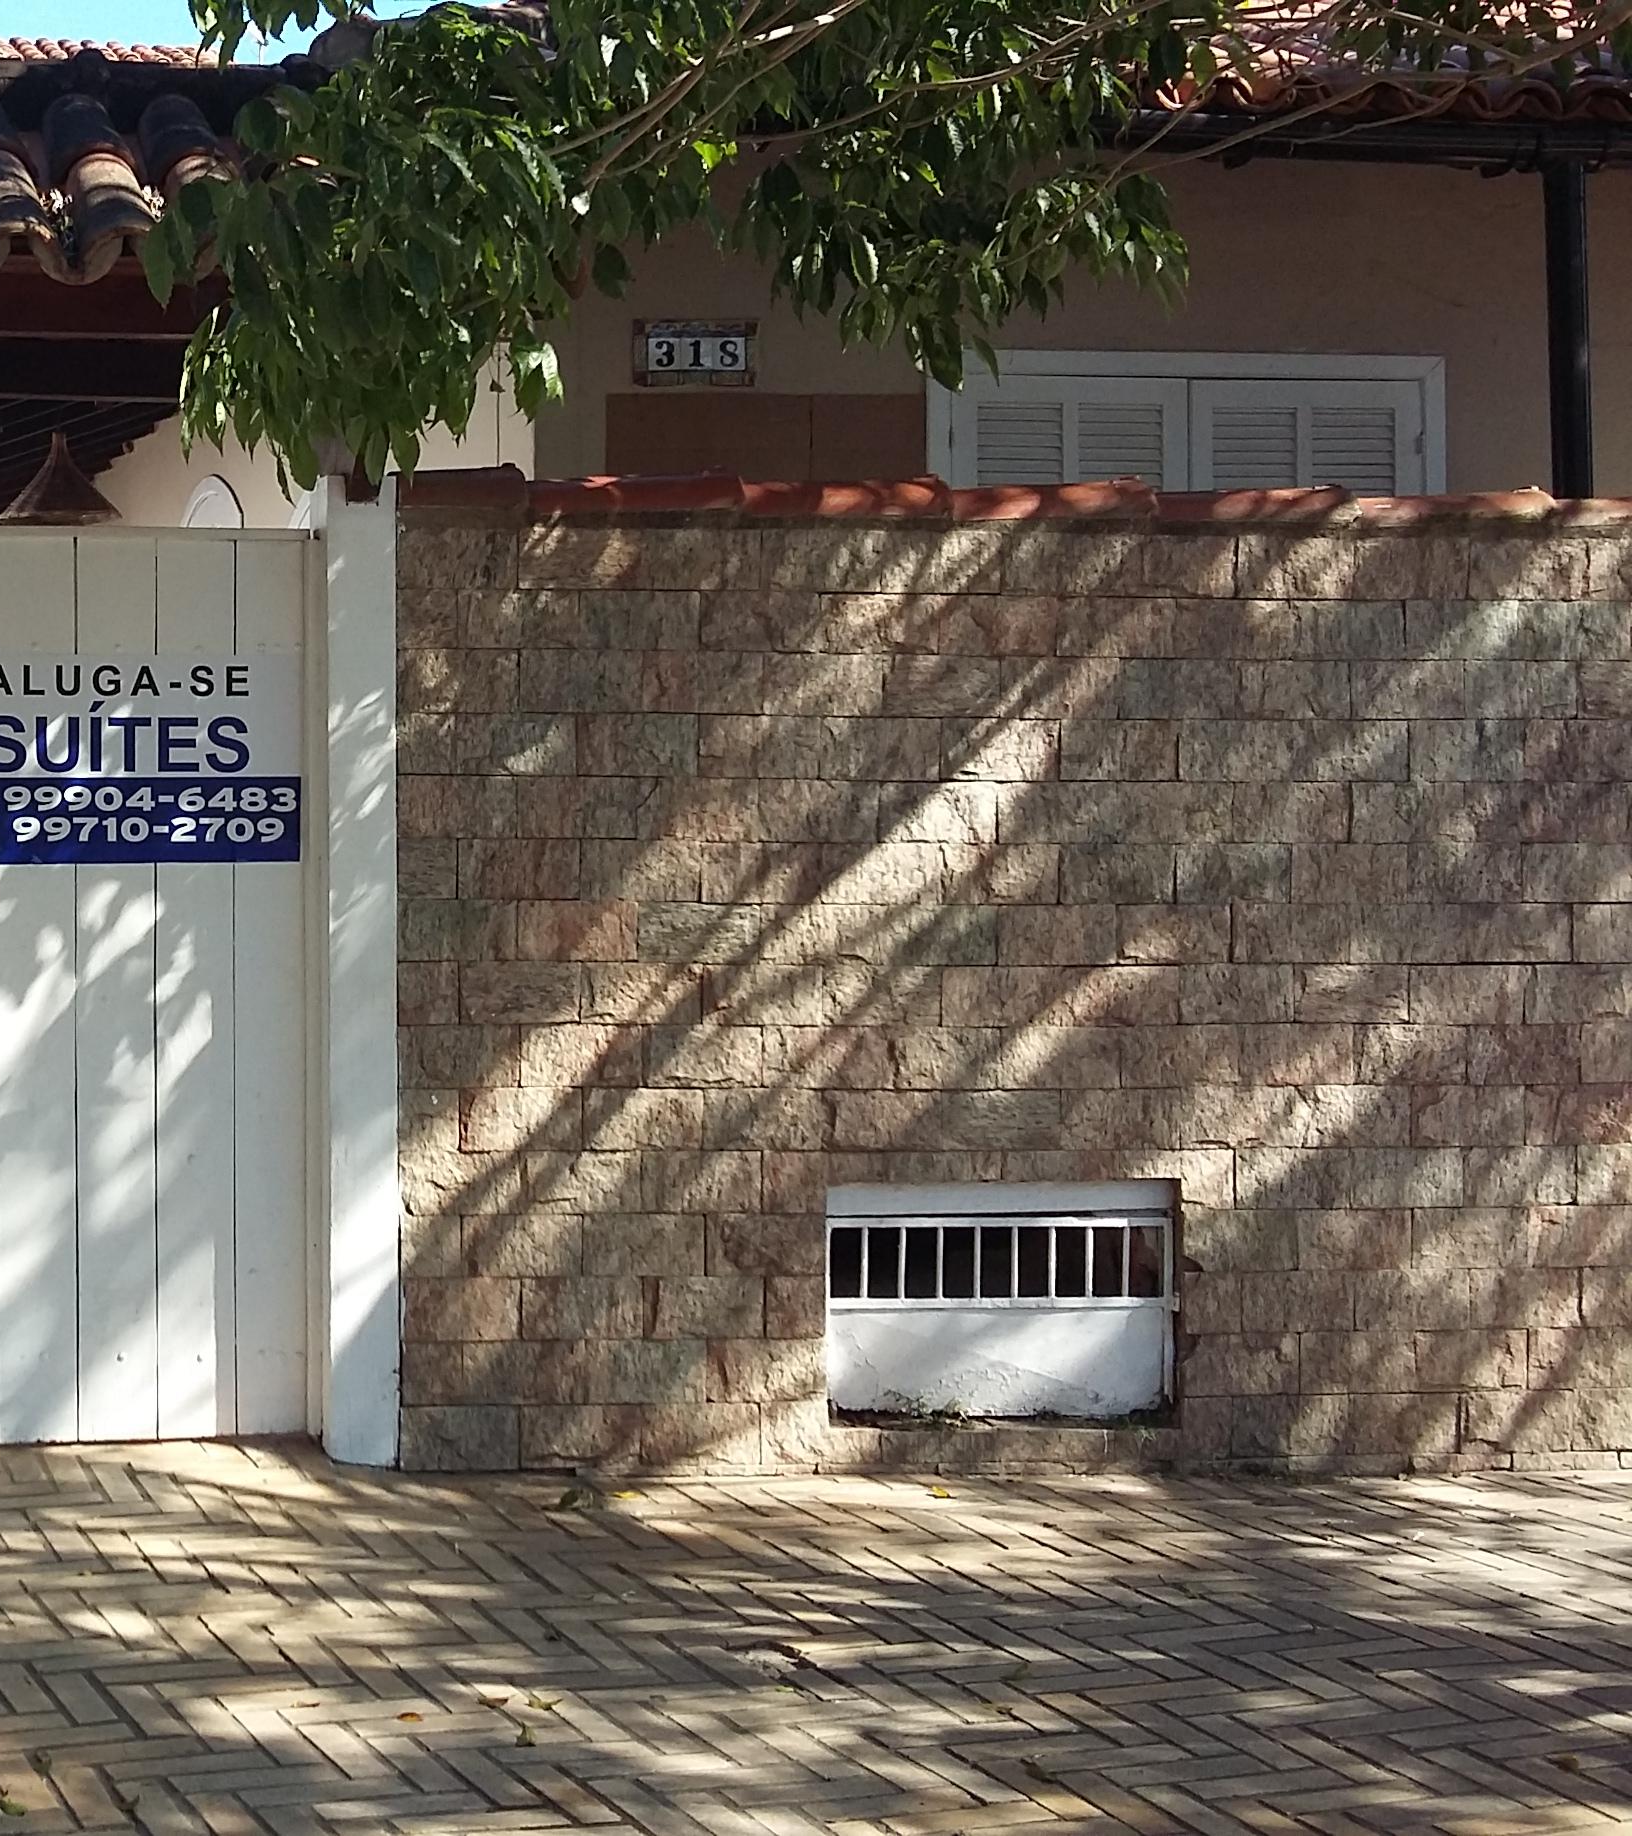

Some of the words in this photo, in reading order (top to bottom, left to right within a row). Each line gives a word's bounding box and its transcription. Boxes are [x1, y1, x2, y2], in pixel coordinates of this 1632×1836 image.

[654, 340, 740, 367] 318
[3, 786, 297, 812] 99904-6483
[12, 816, 285, 843] 99710-2709
